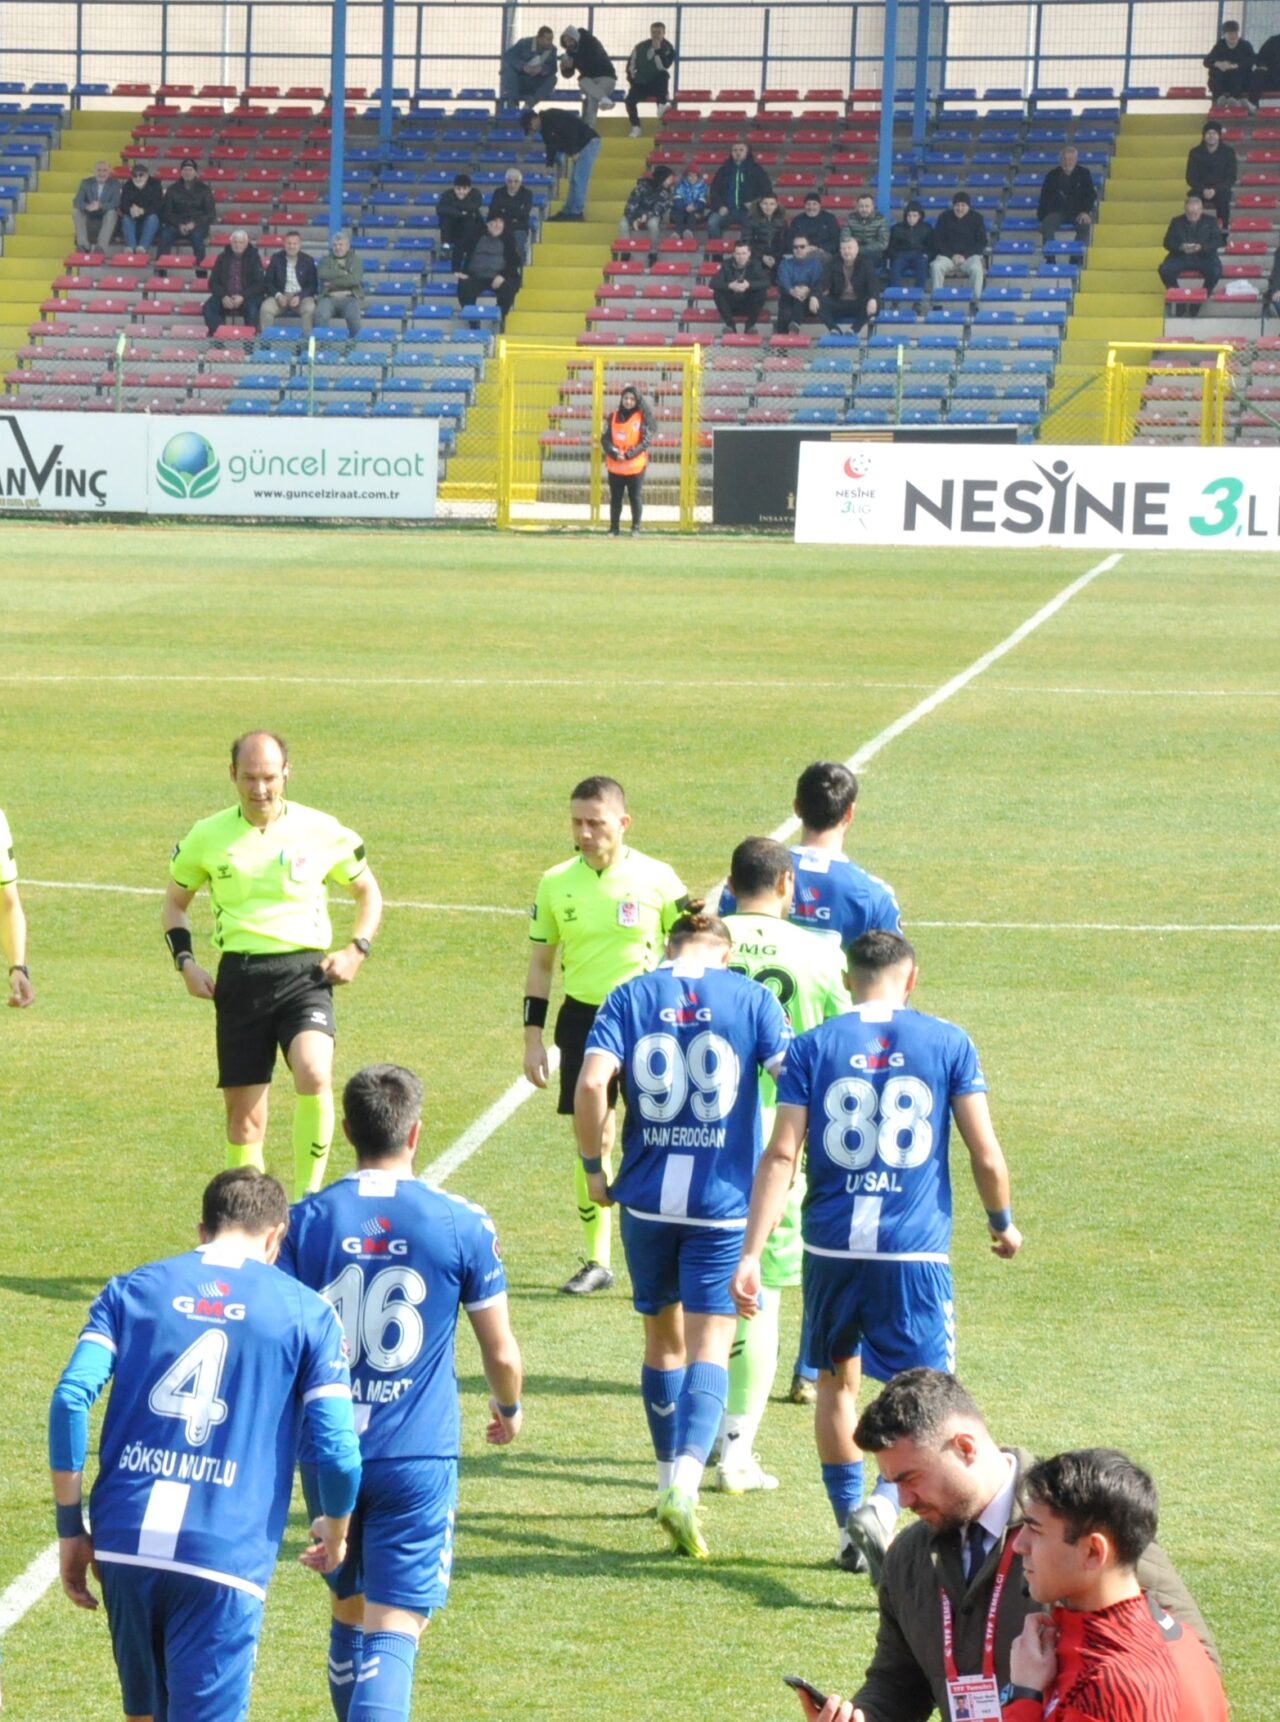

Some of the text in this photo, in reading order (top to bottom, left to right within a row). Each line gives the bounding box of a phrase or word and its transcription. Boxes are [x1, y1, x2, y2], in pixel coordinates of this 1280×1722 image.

[228, 449, 424, 483] güncel ziraat
[253, 488, 400, 500] www.guncelziraat.com.tr
[903, 459, 1170, 536] NESİNE
[1247, 494, 1280, 537] L
[732, 942, 777, 956] MG
[659, 1007, 713, 1024] GMG
[849, 1052, 905, 1070] GMG
[632, 1030, 741, 1123] 99
[671, 1123, 726, 1149] ERDOĞAN
[822, 1075, 934, 1171] 88
[341, 1236, 409, 1256] GMG
[171, 1295, 247, 1321] GMG
[320, 1263, 427, 1373] 16
[148, 1328, 229, 1448] 4
[119, 1441, 238, 1488] GÖKSU MUTLU
